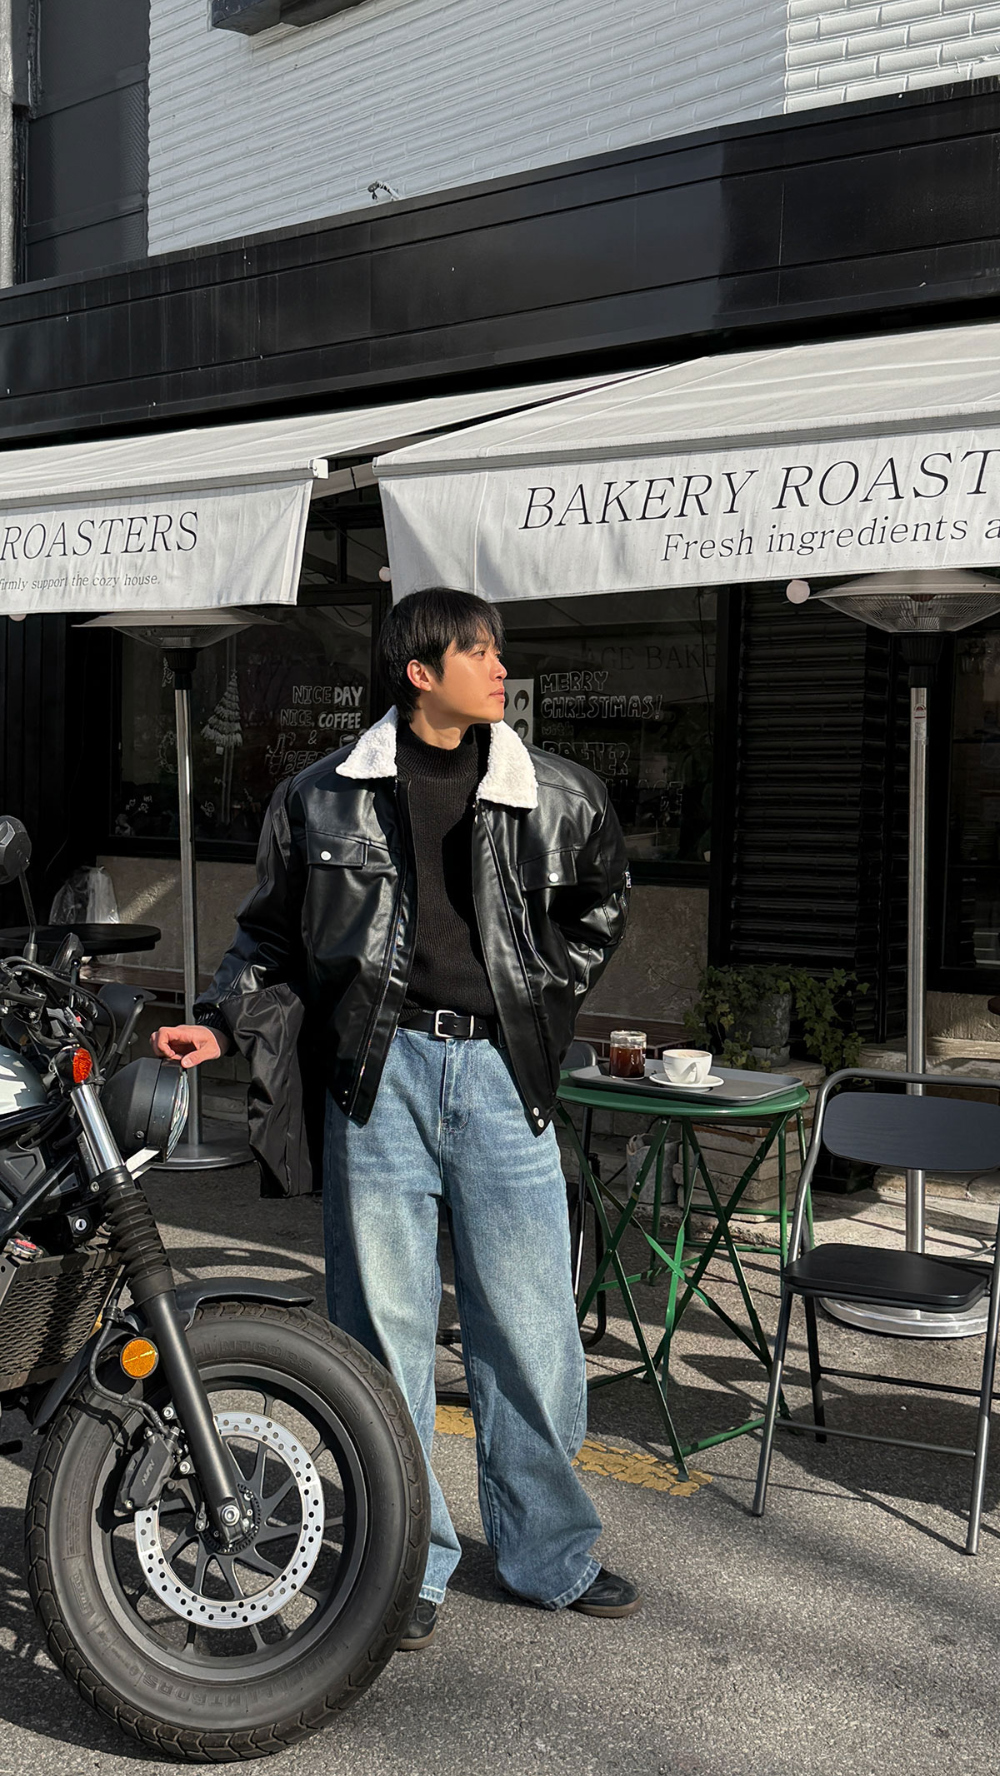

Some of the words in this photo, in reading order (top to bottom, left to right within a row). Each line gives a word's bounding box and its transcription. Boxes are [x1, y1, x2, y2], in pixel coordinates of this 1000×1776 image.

[519, 469, 759, 530] BAKERY
[772, 449, 1000, 510] ROAST
[0, 511, 198, 561] ROASTERS
[661, 529, 753, 562] Fresh
[767, 515, 968, 557] ingredients
[71, 571, 89, 587] the
[92, 574, 119, 587] cozy
[124, 573, 161, 586] house.
[540, 670, 608, 693] MERRY
[292, 686, 332, 704] NICE
[334, 686, 363, 706] DAY
[540, 694, 663, 719] CHRISTMAS!
[318, 711, 361, 729] COFFEE
[307, 729, 318, 745] &
